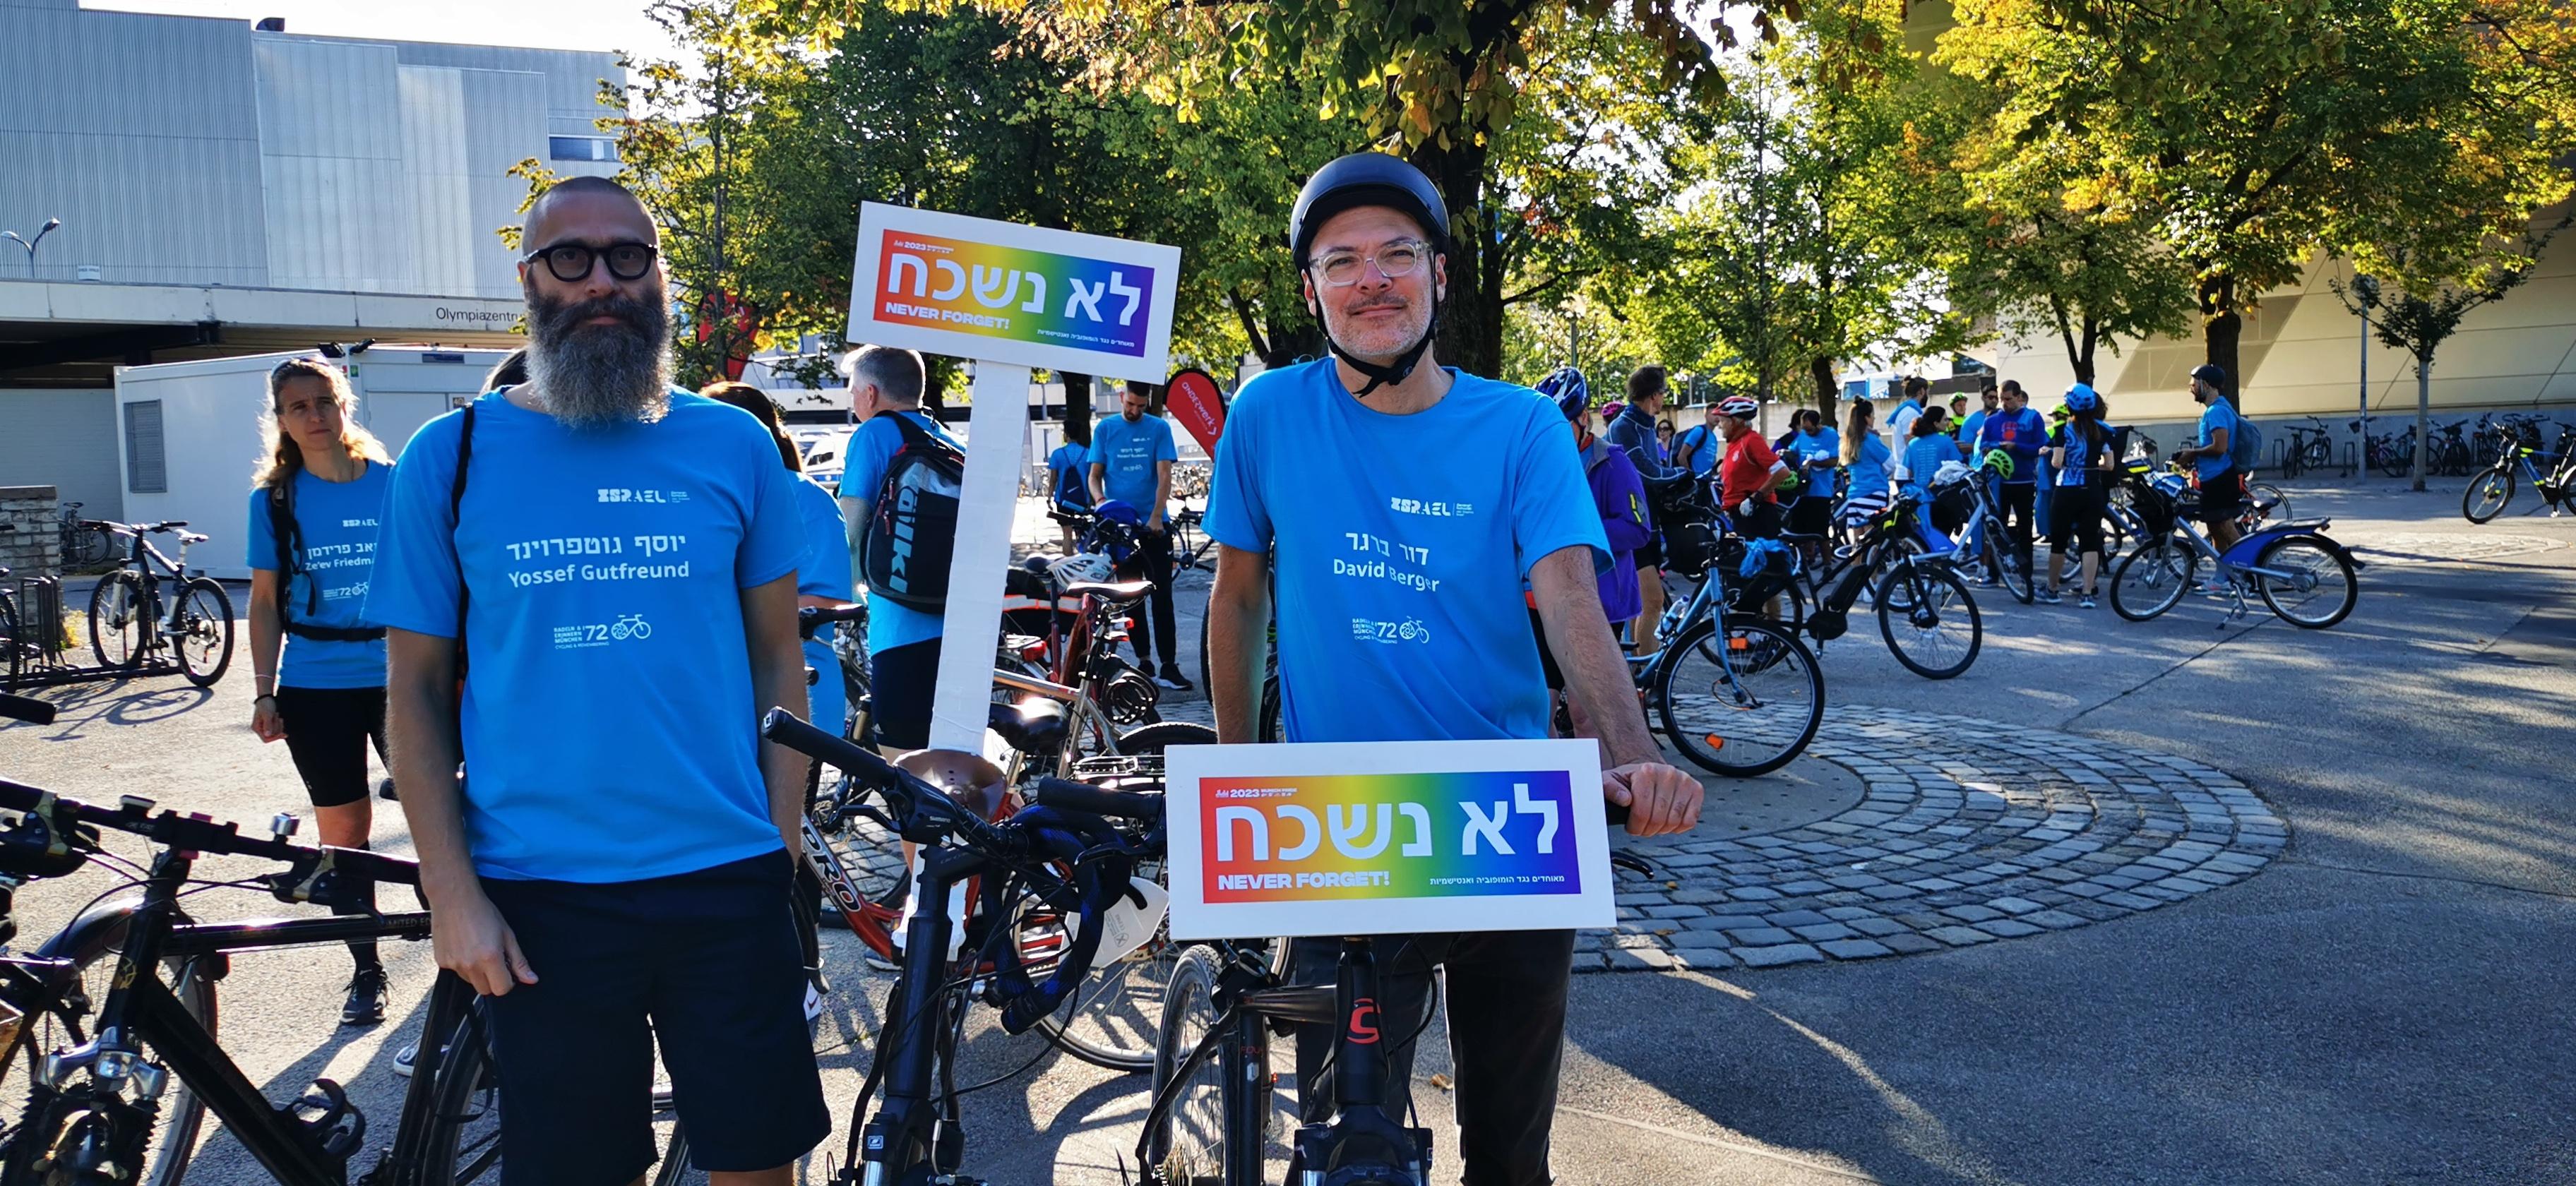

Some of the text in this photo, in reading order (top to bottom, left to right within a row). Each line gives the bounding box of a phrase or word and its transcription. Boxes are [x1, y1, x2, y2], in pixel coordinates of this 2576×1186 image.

[905, 241, 926, 251] 2023
[888, 253, 1141, 326] לא נשכח
[886, 302, 1010, 330] NEVER FORGET!
[597, 489, 667, 503] ISRAEL
[1391, 496, 1451, 517] ISRAEL
[307, 544, 351, 560] פרידמן
[506, 535, 686, 561] יוסף גוטפרוינד
[334, 556, 373, 568] Friedm
[508, 561, 689, 588] Yossef Gutfreund
[1333, 558, 1440, 592] David Berger
[1230, 789, 1260, 798] 2023
[1216, 783, 1559, 862] לא נשכח
[1218, 870, 1390, 890] NEVER FORGET!
